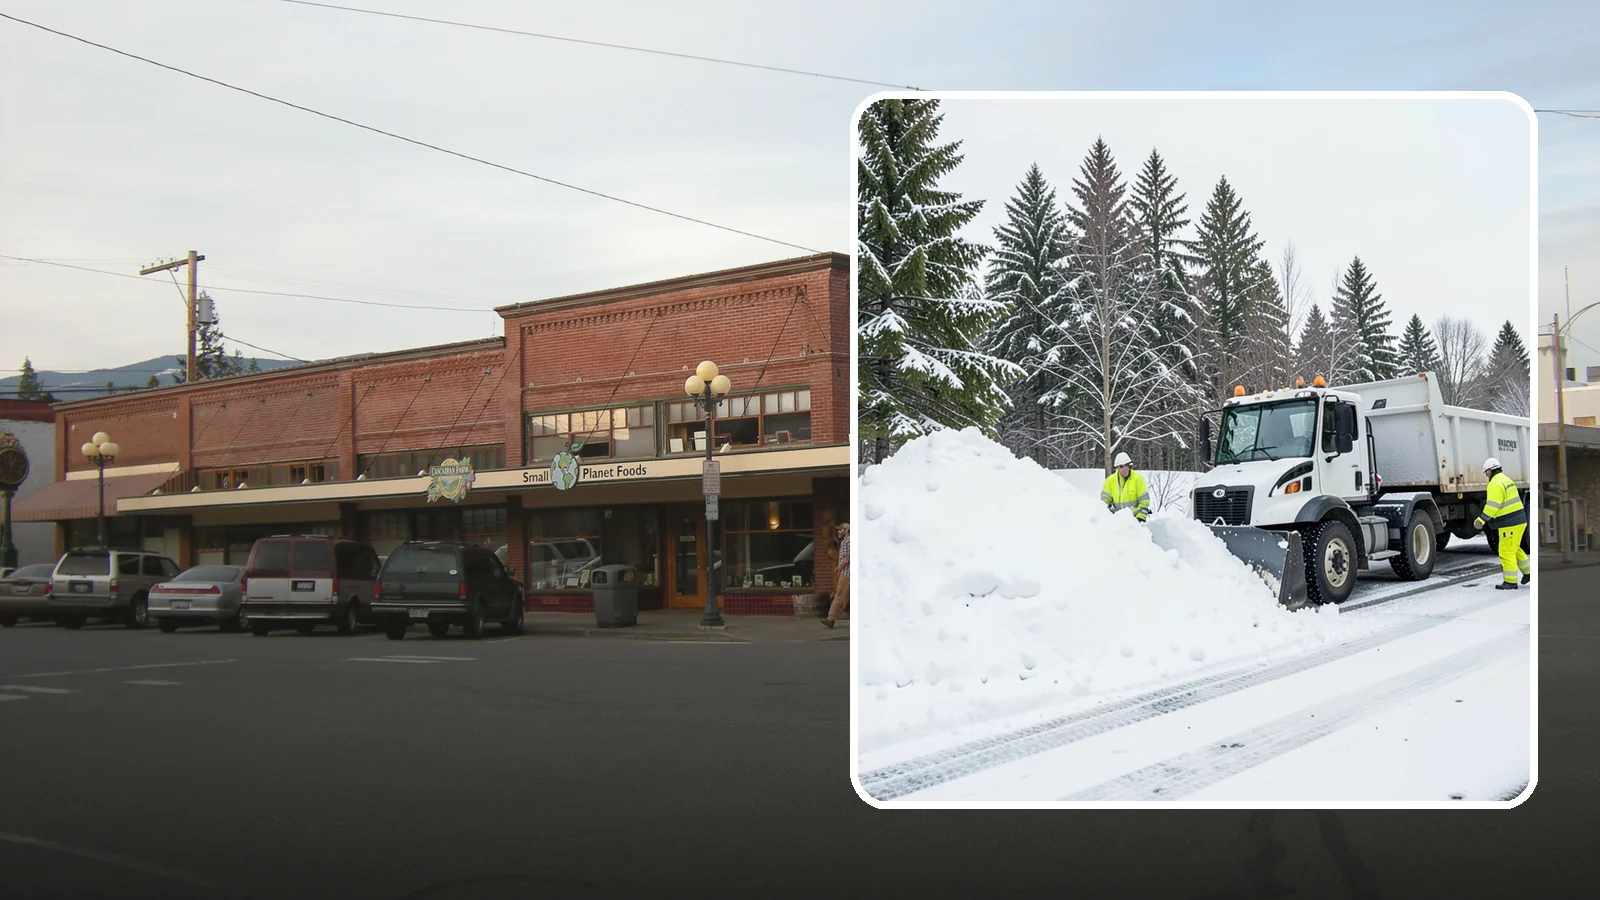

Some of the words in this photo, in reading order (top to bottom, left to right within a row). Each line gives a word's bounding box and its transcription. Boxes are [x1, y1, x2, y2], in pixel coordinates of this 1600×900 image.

[455, 465, 469, 475] FARM
[523, 470, 549, 483] Small
[582, 467, 614, 479] Planet
[616, 464, 647, 477] Foods
